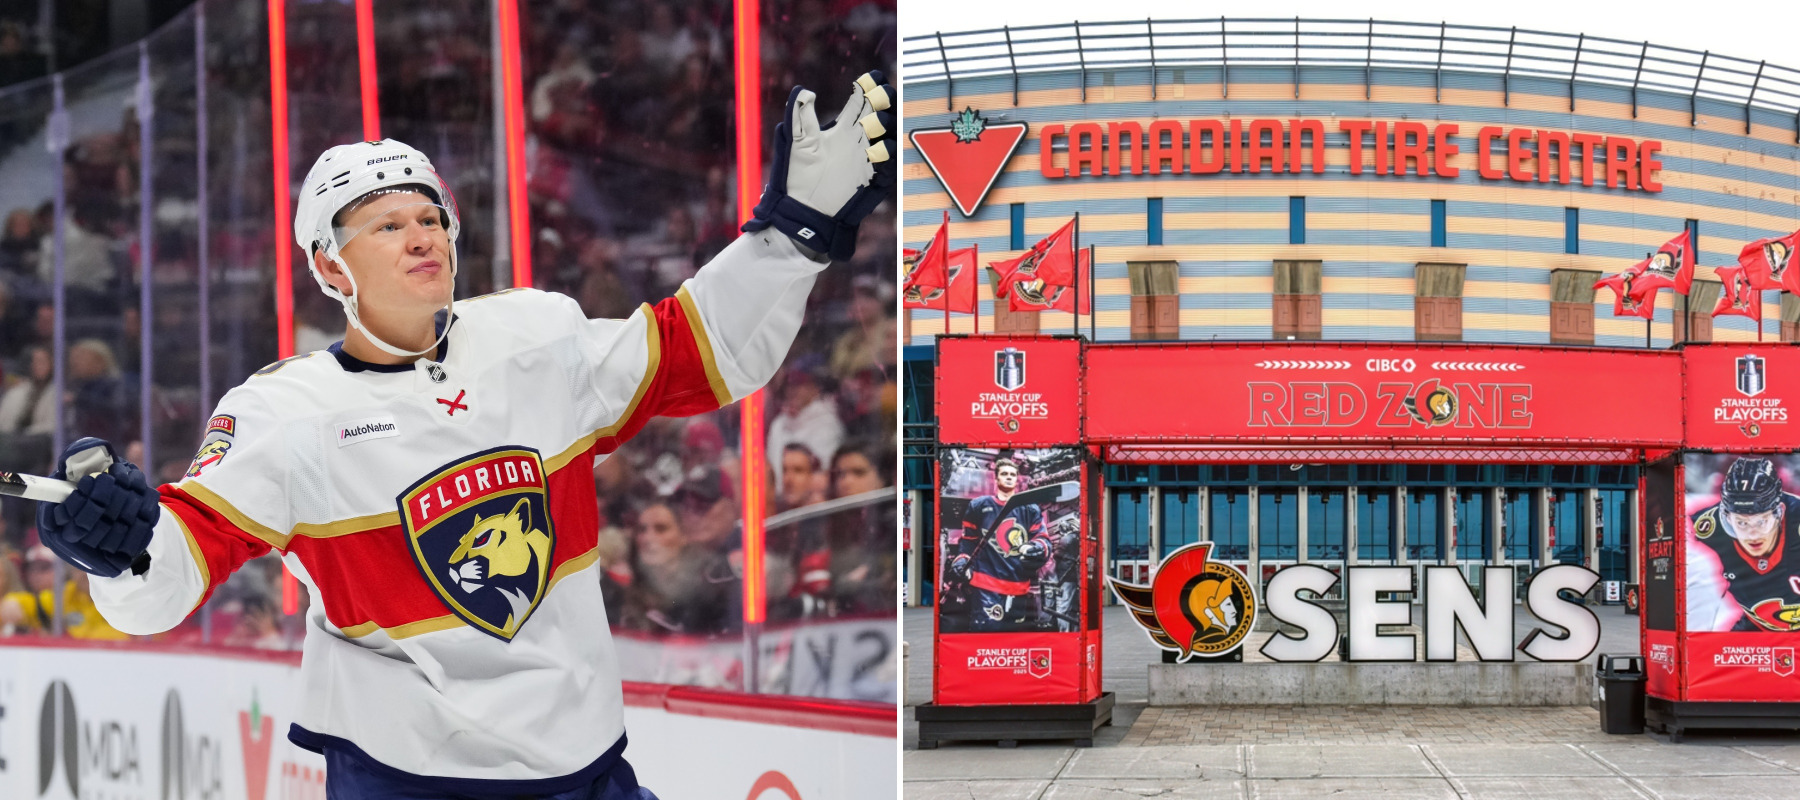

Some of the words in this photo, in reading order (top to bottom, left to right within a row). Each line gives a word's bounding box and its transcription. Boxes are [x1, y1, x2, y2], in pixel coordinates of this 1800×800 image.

[1040, 119, 1325, 178] CANADIAN
[1339, 120, 1460, 177] TIRE
[1478, 126, 1663, 192] CENTRE
[1365, 359, 1400, 372] CIBC
[979, 393, 1020, 402] STANLEY
[1022, 393, 1041, 402] CUP
[1721, 398, 1761, 407] STANLEY
[1762, 398, 1780, 407] CUP
[971, 402, 1048, 416] PLAYOFFS
[1247, 382, 1367, 427] RED
[1714, 408, 1787, 420] PLAYOFFS
[418, 461, 535, 520] FLORIDA
[1740, 480, 1749, 491] 7
[1648, 541, 1673, 559] HEART
[1259, 563, 1602, 663] SENS
[976, 648, 1010, 656] STANLEY
[1011, 648, 1028, 656] CUP
[967, 655, 1028, 667] PLAYOFFS
[1714, 654, 1771, 665] PLAYOFFS
